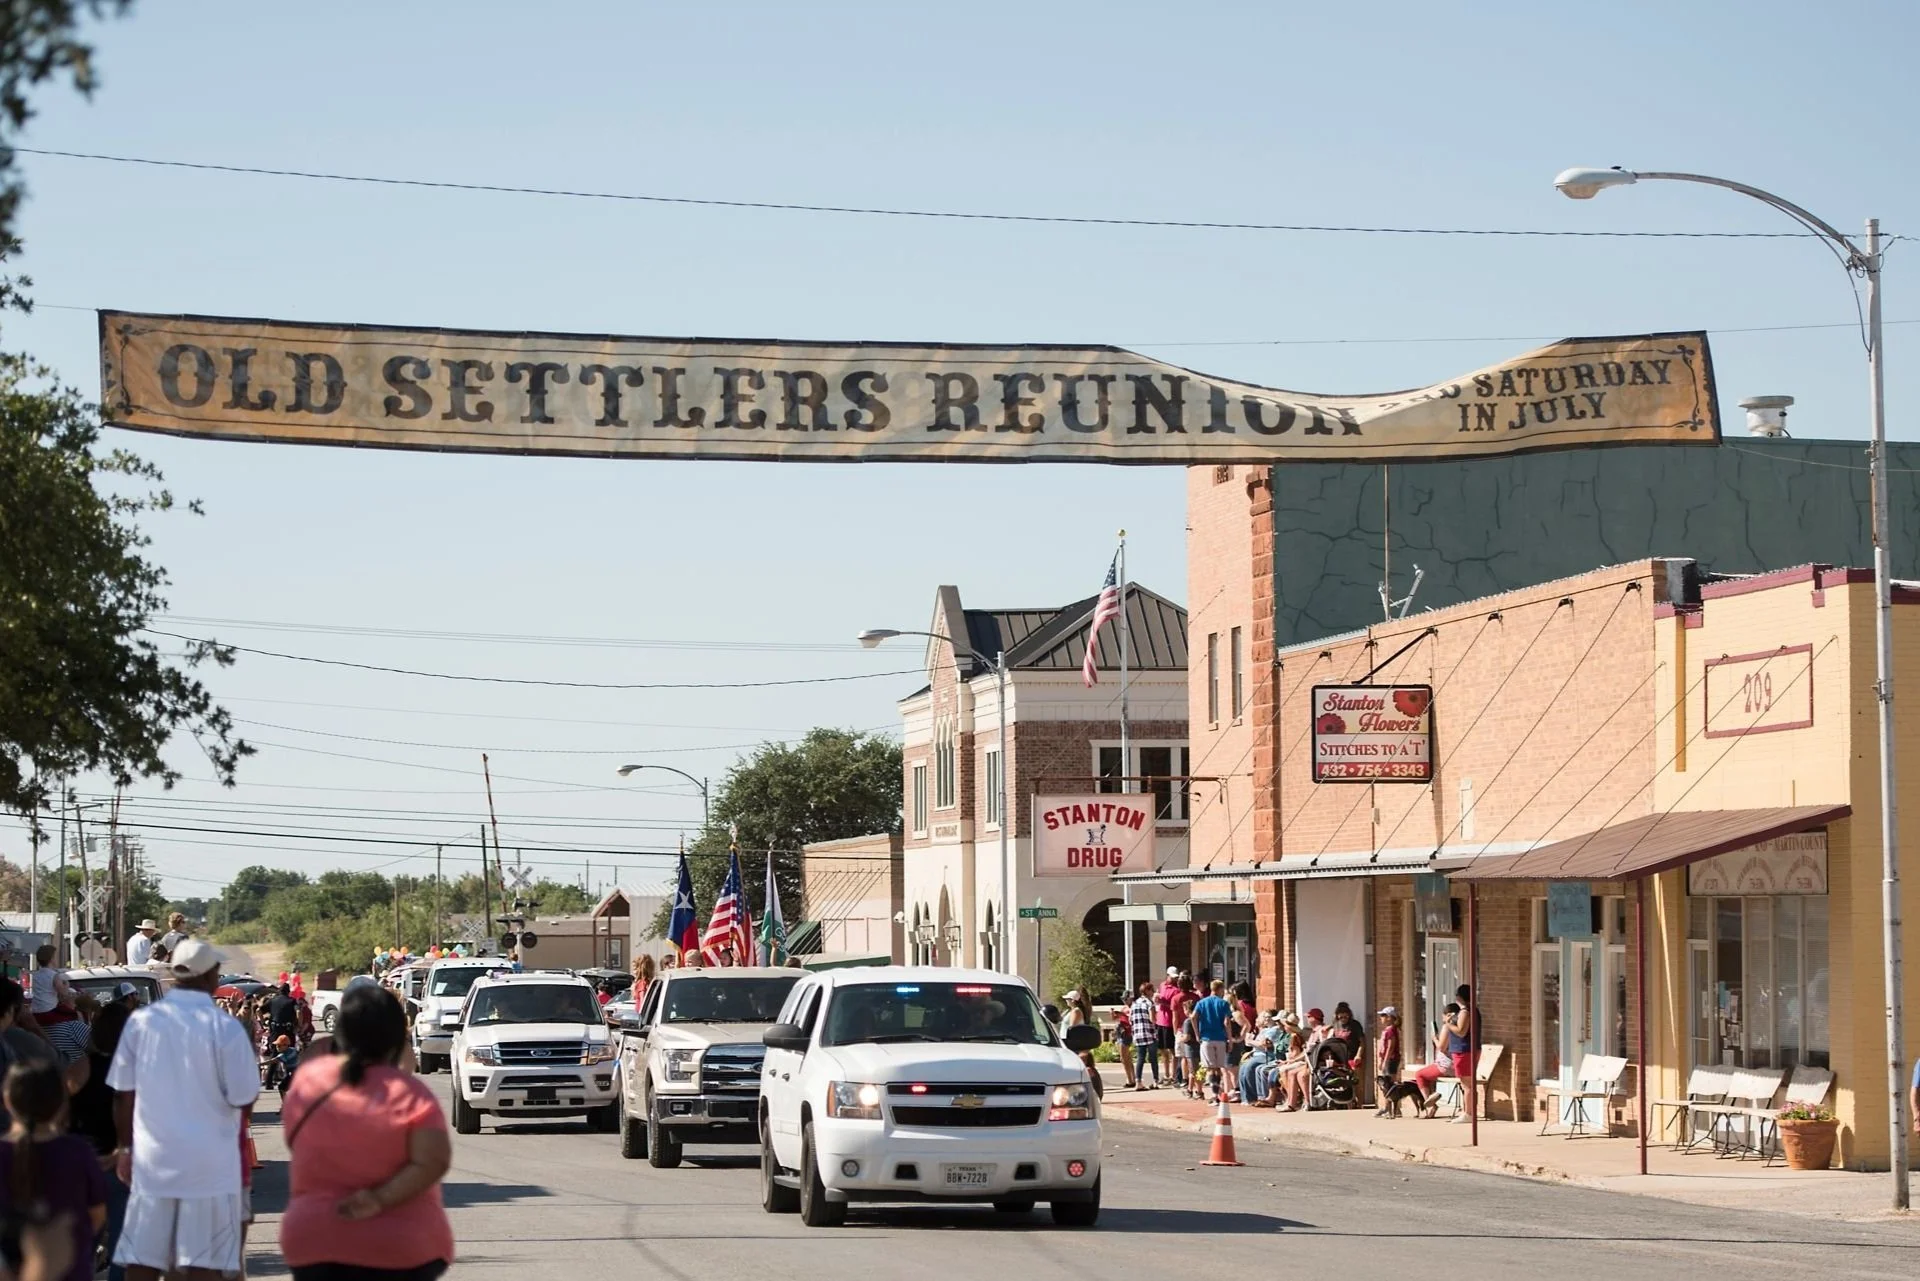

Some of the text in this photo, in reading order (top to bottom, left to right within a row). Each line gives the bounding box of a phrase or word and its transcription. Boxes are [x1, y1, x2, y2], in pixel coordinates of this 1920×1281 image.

[158, 344, 348, 414] OLD
[383, 354, 891, 433] SETTLERS
[1473, 359, 1671, 398] SATURDAY
[1457, 392, 1607, 432] IN JULY
[1322, 692, 1385, 711] Stanton
[1743, 671, 1772, 713] 209
[1358, 712, 1421, 732] Flowers
[1320, 742, 1378, 756] STITCHES
[1400, 745, 1408, 756] A
[1043, 803, 1146, 831] STANTON
[1067, 847, 1123, 868] DRUG
